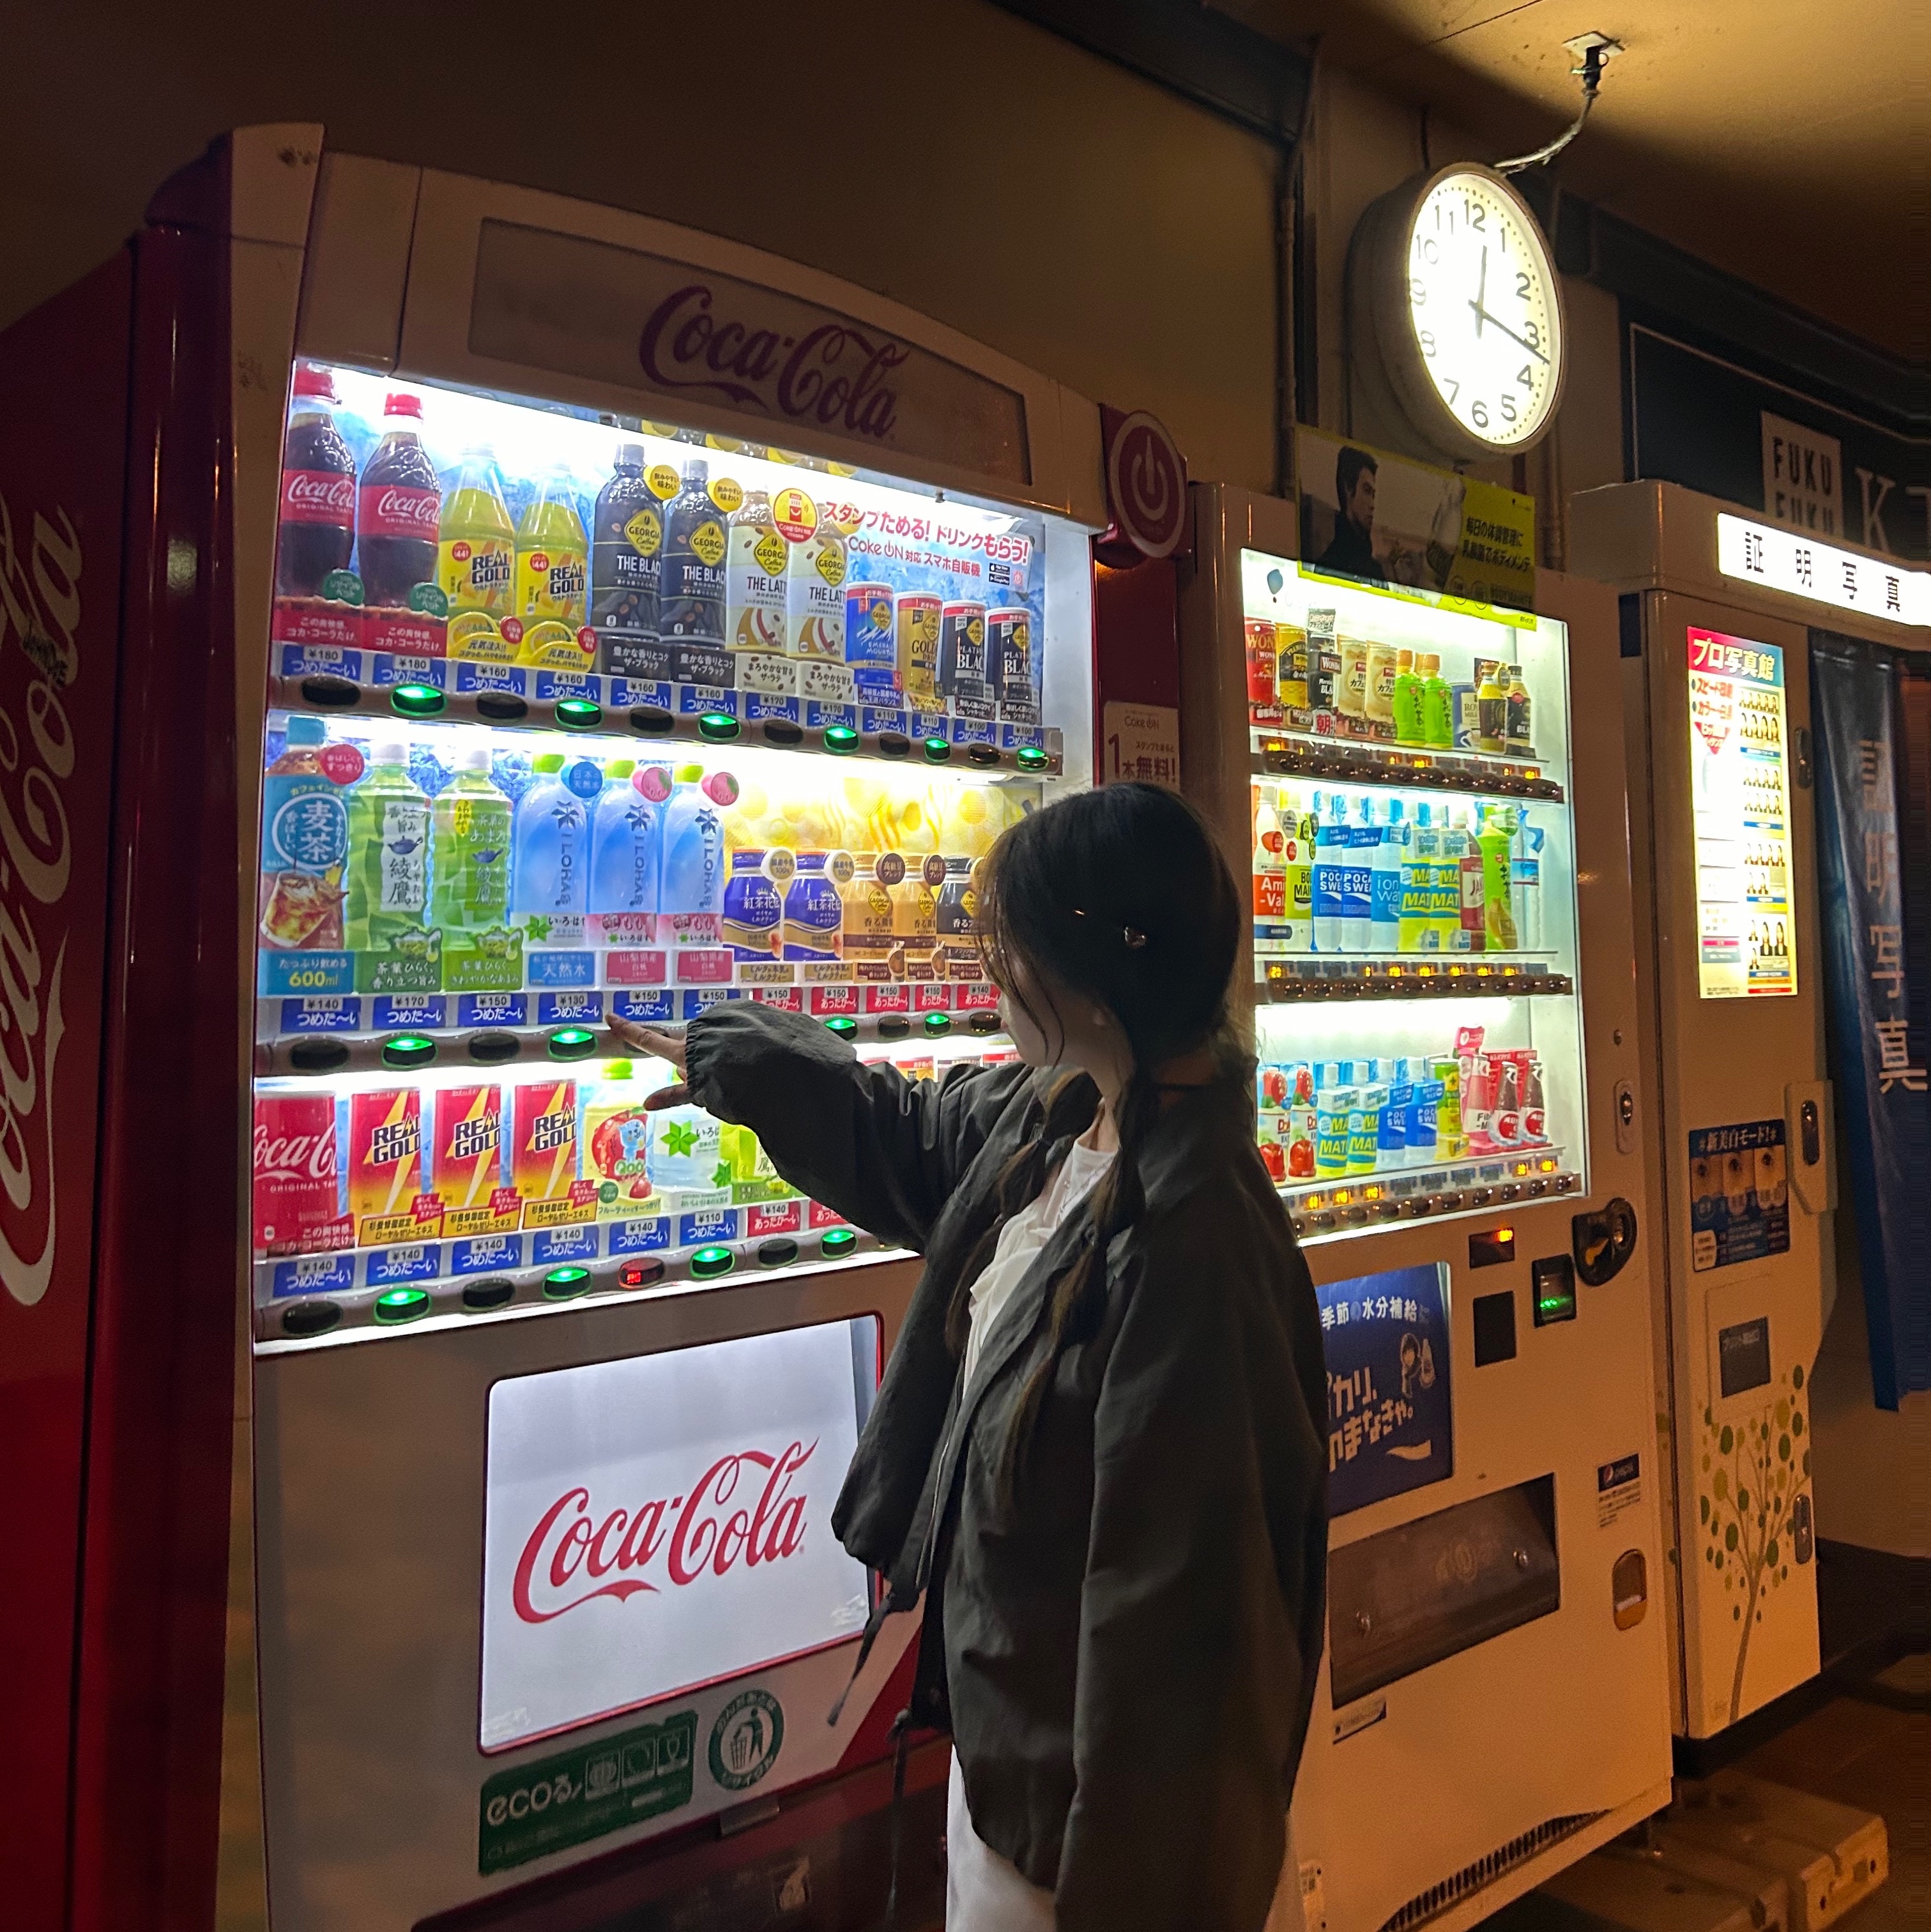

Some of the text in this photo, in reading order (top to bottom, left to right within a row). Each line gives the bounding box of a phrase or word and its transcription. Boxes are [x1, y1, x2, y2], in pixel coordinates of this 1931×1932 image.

[1435, 204, 1454, 236] 11
[1464, 199, 1486, 233] 12
[1500, 227, 1506, 253] 1
[1416, 234, 1439, 264] 10
[1410, 278, 1426, 306] 9
[1516, 272, 1531, 301] 2
[1524, 321, 1540, 349] 3
[1420, 330, 1437, 358] 8
[641, 285, 910, 437] Coca-Cola
[1516, 364, 1534, 391] 4
[1444, 377, 1460, 405] 7
[1471, 400, 1489, 429] 6
[1500, 393, 1517, 422] 5
[1773, 436, 1832, 496] FUKU
[936, 525, 1028, 564] ドリンクもらう!
[472, 549, 509, 570] REAL
[617, 554, 638, 571] THE
[848, 535, 882, 556] Coke
[924, 551, 981, 577] スマホ自販機
[471, 567, 510, 584] GOLD
[550, 561, 586, 581] REAL
[682, 565, 702, 581] THE
[1744, 531, 1900, 612] 証明写真
[550, 577, 584, 595] GOLD
[747, 576, 767, 591] THE
[809, 586, 828, 601] THE
[309, 649, 339, 660] ¥180
[613, 646, 669, 662] 豊かな香りとコク
[680, 653, 734, 669] 豊かな香りとコク
[1693, 637, 1776, 681] プロ写真館
[399, 659, 427, 670] ¥180
[623, 657, 659, 670] ザ・ブラック
[691, 664, 725, 676] ザ・ブラック
[748, 662, 793, 677] まろやかな甘さ
[480, 666, 507, 678] ¥160
[556, 674, 583, 685] ¥160
[761, 673, 782, 683] ザ・ラテ
[809, 671, 851, 687] まろやかな甘さ
[630, 682, 655, 693] ¥160
[698, 689, 721, 699] ¥160
[821, 682, 841, 693] ザ・ラテ
[763, 696, 784, 706] ¥170
[823, 704, 842, 714] ¥170
[877, 710, 896, 720] ¥110
[924, 717, 938, 726] ¥110
[298, 800, 334, 862] 麦茶
[387, 857, 413, 907] 綾鷹
[543, 962, 587, 978] 天然水
[289, 970, 340, 987] 600ml
[634, 991, 658, 1001] ¥150
[703, 991, 726, 1001] ¥150
[767, 989, 788, 1000] ¥150
[826, 988, 846, 998] ¥150
[880, 986, 897, 996] ¥150
[926, 986, 941, 996] ¥150
[972, 984, 990, 994] ¥140
[308, 998, 339, 1010] ¥140
[395, 996, 425, 1007] ¥170
[455, 1109, 501, 1142] REAL
[535, 1103, 577, 1135] REAL
[374, 1112, 421, 1147] REAL
[615, 1160, 645, 1175] Qoo
[270, 1182, 320, 1194] ORIGINAL
[537, 1210, 590, 1223] ローヤルゼリーエキス
[765, 1204, 786, 1215] ¥140
[455, 1218, 512, 1232] ローヤルゼリーエキス
[699, 1213, 721, 1224] ¥110
[374, 1226, 434, 1241] ローヤルゼリーエキス
[556, 1229, 581, 1240] ¥140
[629, 1221, 653, 1233] ¥140
[475, 1239, 503, 1251] ¥140
[392, 1249, 420, 1261] ¥140
[303, 1260, 333, 1272] ¥140
[1327, 1366, 1378, 1422] カリ、
[513, 1437, 820, 1623] Coca-Cola
